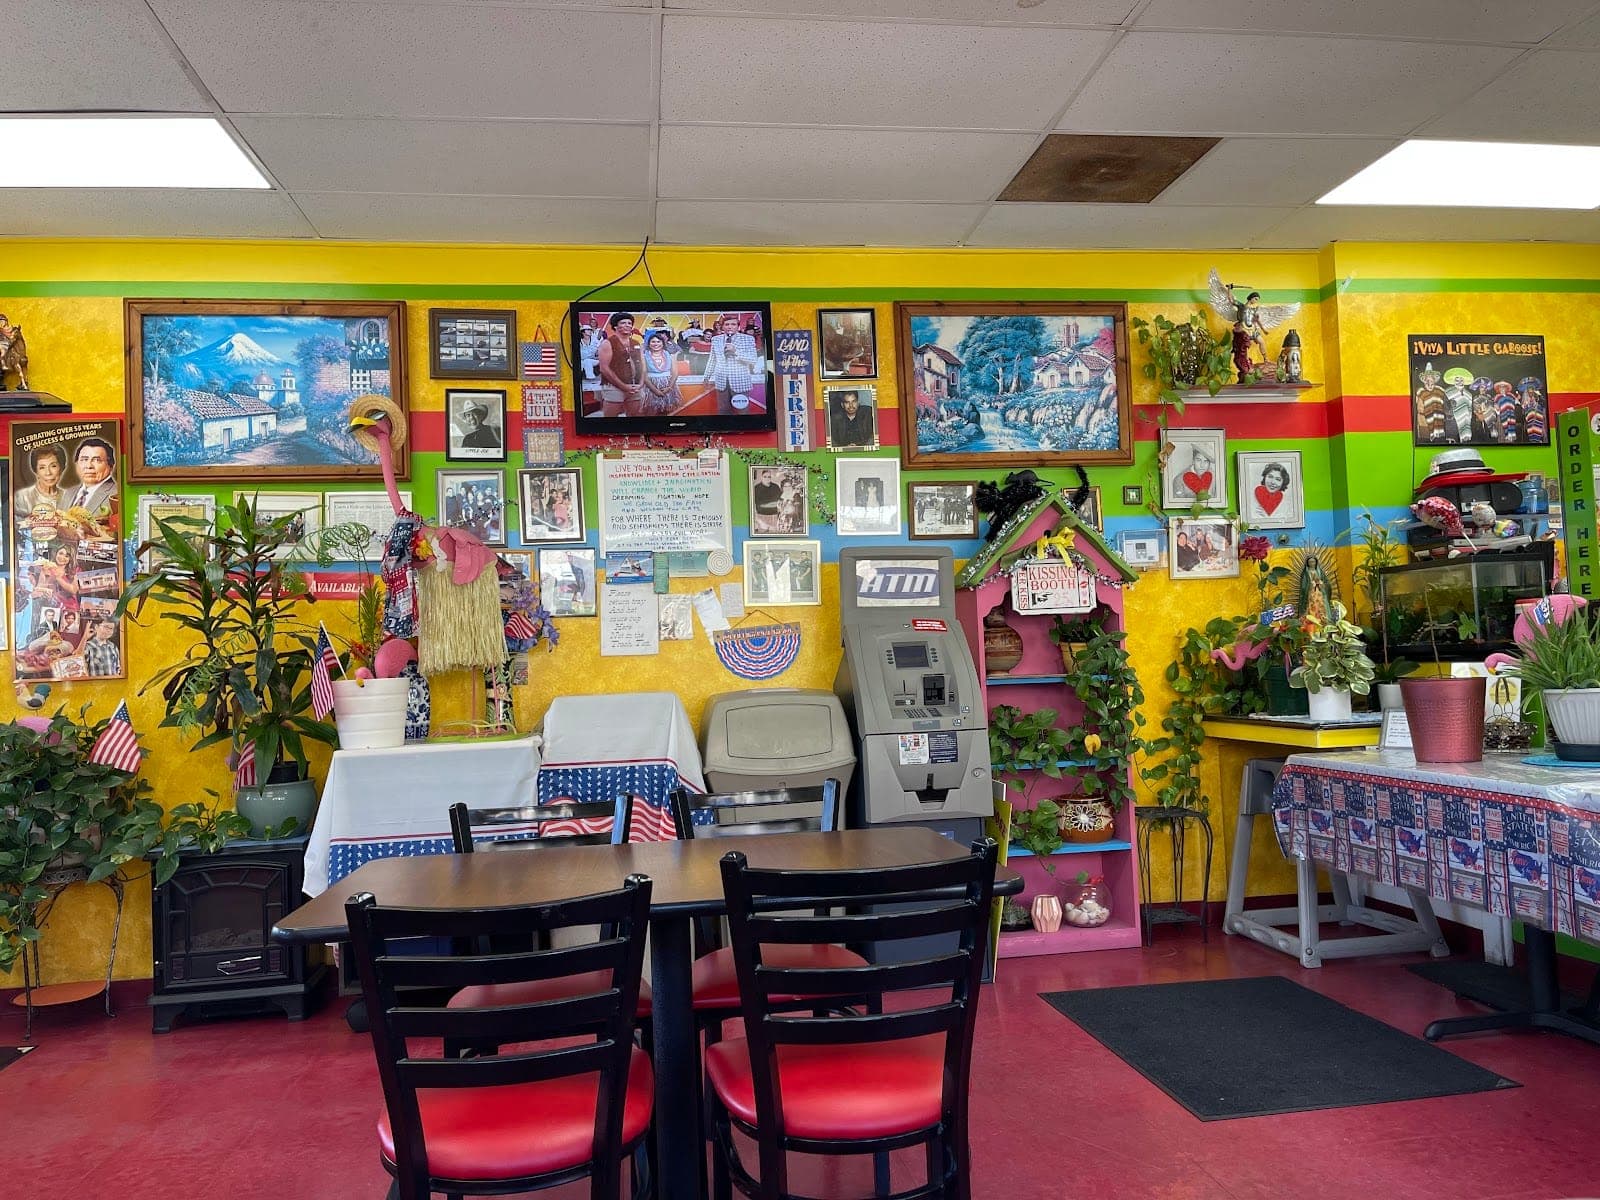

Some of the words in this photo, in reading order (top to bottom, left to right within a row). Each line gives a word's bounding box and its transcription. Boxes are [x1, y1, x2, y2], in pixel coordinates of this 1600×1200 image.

[777, 338, 809, 353] LAND
[1414, 341, 1443, 356] ¡VIVA
[1446, 341, 1490, 356] LITTLE
[1493, 341, 1541, 356] CABOOSE!
[528, 406, 556, 417] JULY
[788, 380, 804, 446] FREE
[15, 428, 56, 446] CELEBRATING
[56, 426, 74, 436] OVER
[82, 423, 102, 431] YEARS
[33, 438, 59, 449] SUCCESS
[64, 430, 97, 440] GROWING!
[615, 465, 631, 473] LIVE
[635, 464, 652, 472] YOUR
[657, 464, 673, 472] BEST
[1567, 426, 1586, 511] ORDER
[611, 515, 624, 523] FOR
[626, 514, 651, 523] WHERE
[658, 514, 678, 522] THERE
[681, 514, 689, 522] IS
[671, 521, 694, 529] THERE
[1576, 527, 1592, 596] HERE
[1028, 566, 1077, 580] KISSING
[859, 573, 938, 594] ATM
[1031, 579, 1076, 591] BOOTH
[1019, 588, 1028, 609] KISS
